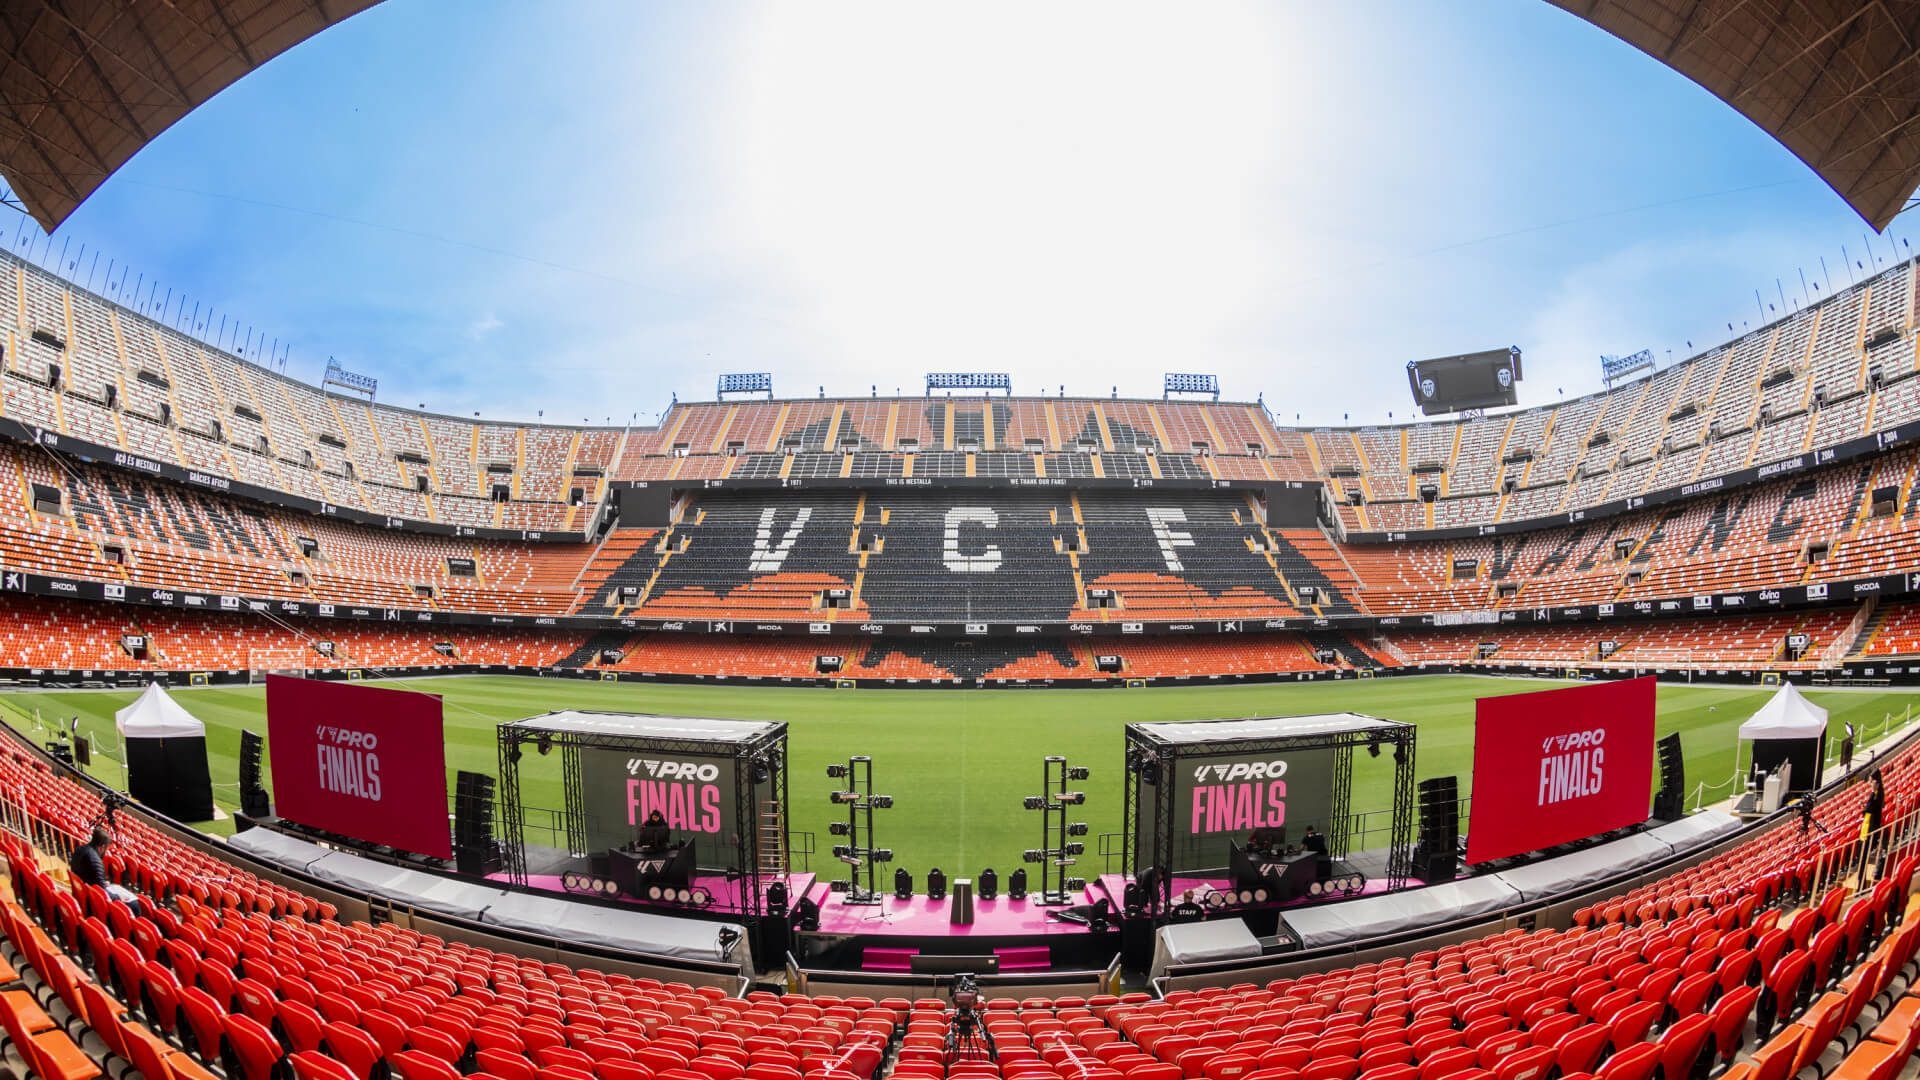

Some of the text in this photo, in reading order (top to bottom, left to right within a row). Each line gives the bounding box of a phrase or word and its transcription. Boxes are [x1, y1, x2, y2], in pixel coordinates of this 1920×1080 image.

[1884, 432, 1897, 443] 2004
[1822, 450, 1834, 460] 2004
[136, 457, 160, 473] MESTALLA
[1701, 478, 1723, 492] MESTALLA
[748, 507, 1196, 572] V C F
[50, 582, 77, 592] SKODA
[1853, 582, 1880, 592] SKODA
[152, 590, 173, 601] divina
[1759, 590, 1780, 601] divina
[281, 602, 299, 611] divina
[1634, 602, 1651, 610] divina
[860, 624, 882, 632] divina
[1380, 617, 1400, 625] AMSTEL
[336, 728, 378, 749] PRO
[1565, 728, 1606, 751] PRO
[317, 743, 381, 801] FINALS
[657, 761, 719, 782] PRO
[1225, 760, 1288, 782] PRO
[1538, 747, 1605, 806] FINALS
[626, 779, 721, 833] FINALS
[1191, 780, 1287, 834] FINALS
